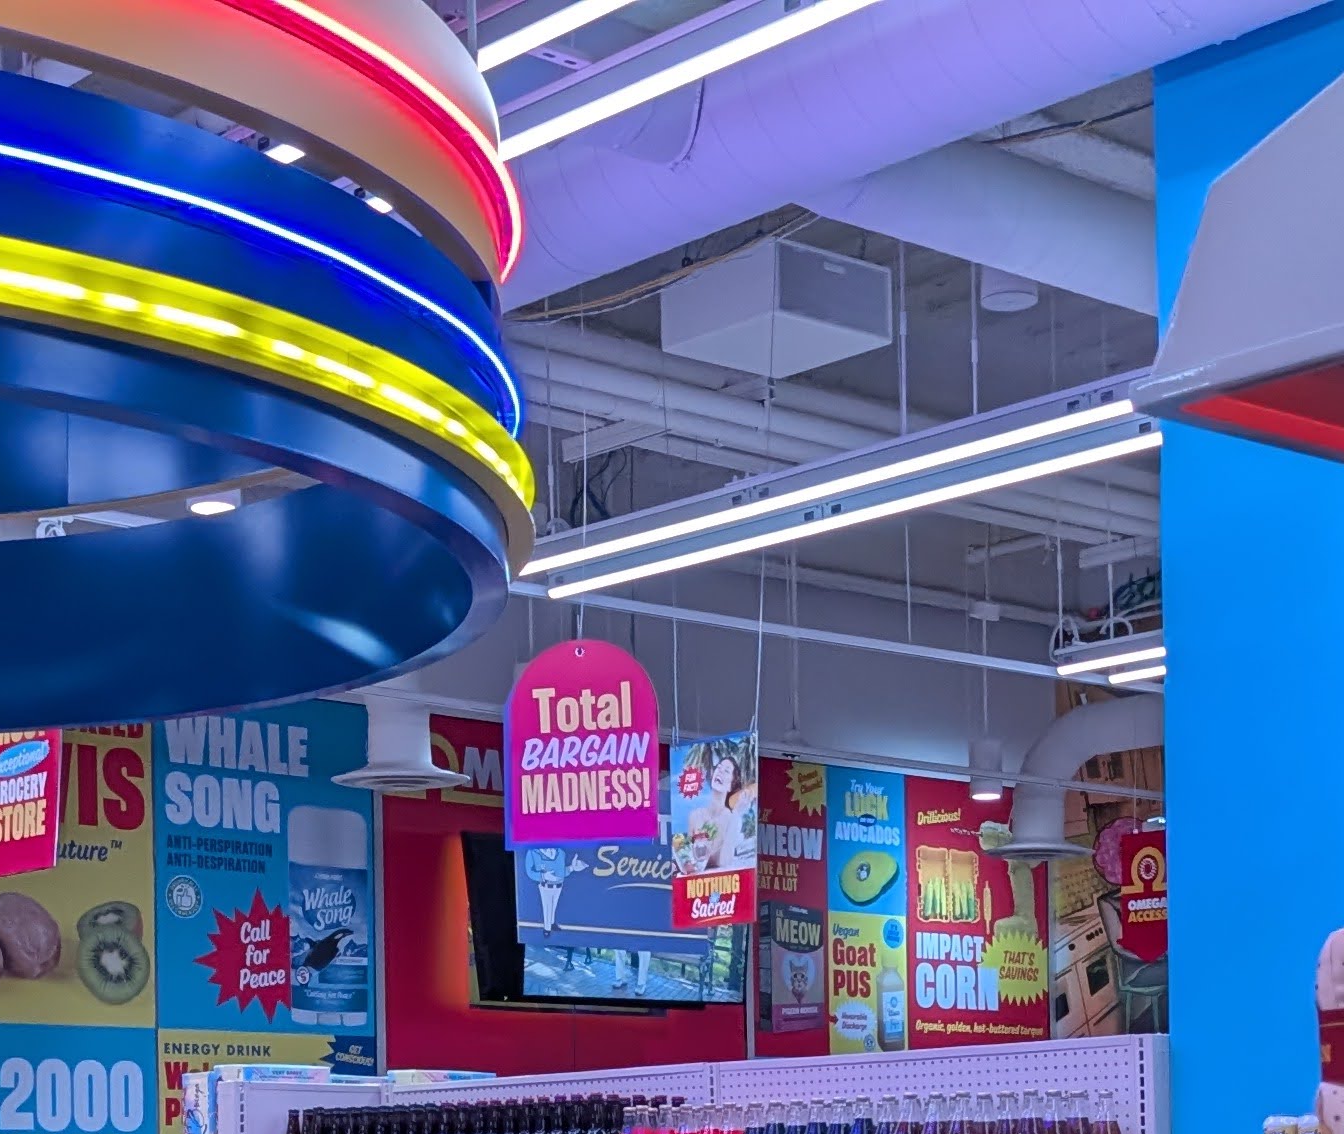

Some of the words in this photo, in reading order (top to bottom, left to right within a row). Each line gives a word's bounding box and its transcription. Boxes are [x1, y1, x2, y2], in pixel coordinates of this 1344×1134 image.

[532, 681, 632, 733] Total
[163, 716, 309, 777] WHALE
[521, 731, 650, 770] BARGAIN
[164, 772, 282, 834] SONG
[166, 834, 273, 858] ANTI-PERSPIRATION
[758, 823, 823, 860] MEOW
[834, 821, 901, 847] AVOCADOS
[166, 852, 266, 874] ANTI-DESPIRATION
[593, 846, 674, 880] Servic
[303, 886, 352, 910] Whale
[687, 874, 740, 899] NOTHING
[691, 895, 735, 919] Sacred
[240, 919, 271, 943] Call
[776, 916, 821, 947] MEOW
[246, 945, 270, 966] for
[833, 938, 877, 968] Goat
[916, 932, 984, 962] IMPACT
[1003, 951, 1036, 965] THAT'S
[239, 968, 286, 991] Peace
[833, 969, 871, 998] PUS
[916, 962, 999, 1011] CORN
[999, 966, 1039, 982] SAVINGS
[164, 1042, 220, 1056] ENERGY
[227, 1044, 271, 1057] DRINK
